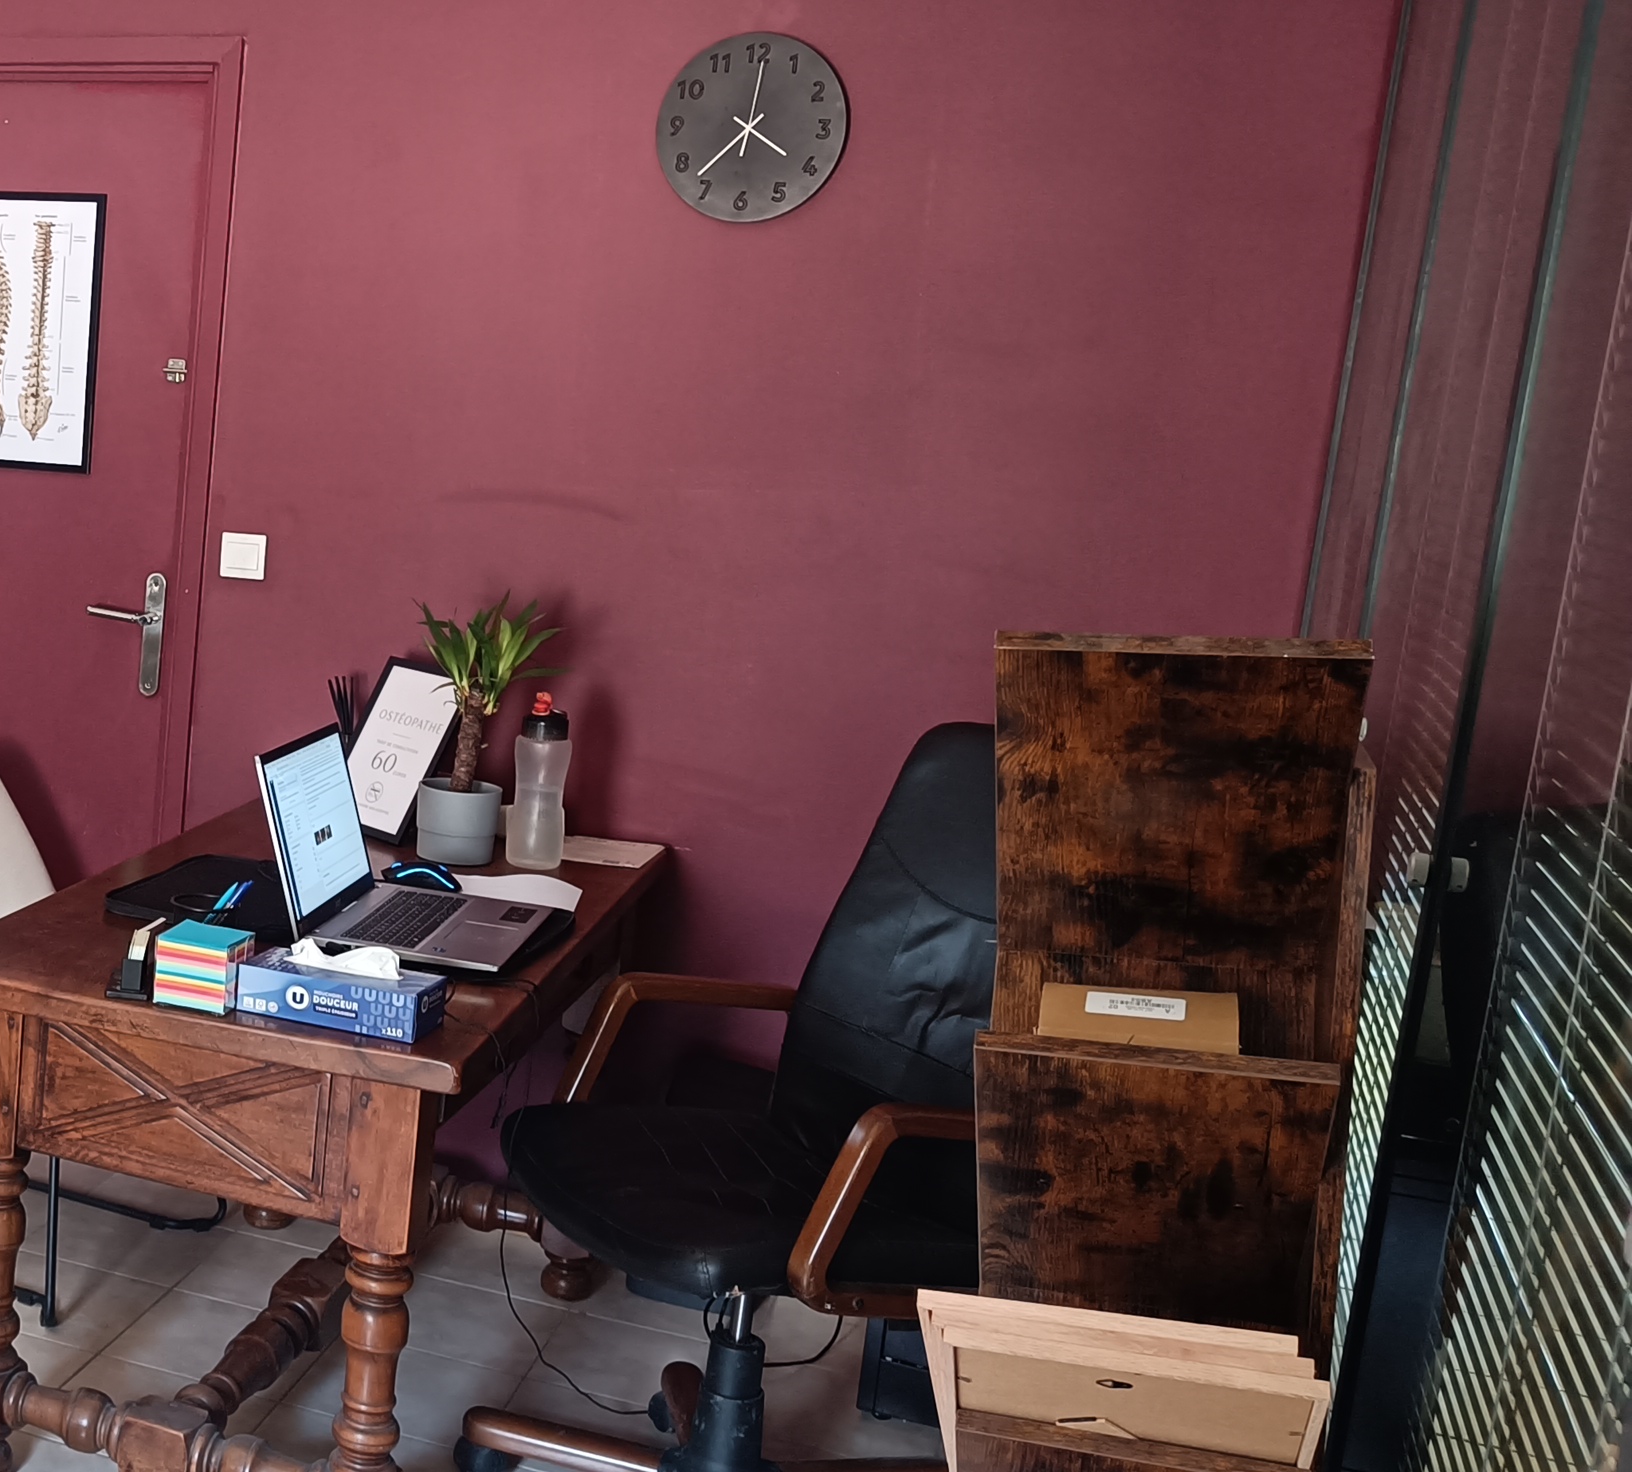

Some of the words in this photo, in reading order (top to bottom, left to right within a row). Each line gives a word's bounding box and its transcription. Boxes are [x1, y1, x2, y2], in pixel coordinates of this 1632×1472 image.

[710, 53, 731, 73] 11
[746, 42, 771, 64] 12
[789, 53, 799, 74] 1
[677, 79, 705, 100] 10
[811, 80, 825, 102] 2
[670, 115, 685, 136] 9
[815, 118, 831, 140] 3
[675, 152, 690, 173] 8
[801, 155, 817, 176] 4
[698, 179, 712, 200] 7
[771, 181, 786, 202] 5
[733, 190, 748, 211] 6
[379, 709, 444, 734] OSTÉOPATHE
[371, 750, 397, 773] 60
[292, 991, 305, 1005] U
[313, 995, 359, 1011] DOUCEUR
[381, 1026, 403, 1038] x110
